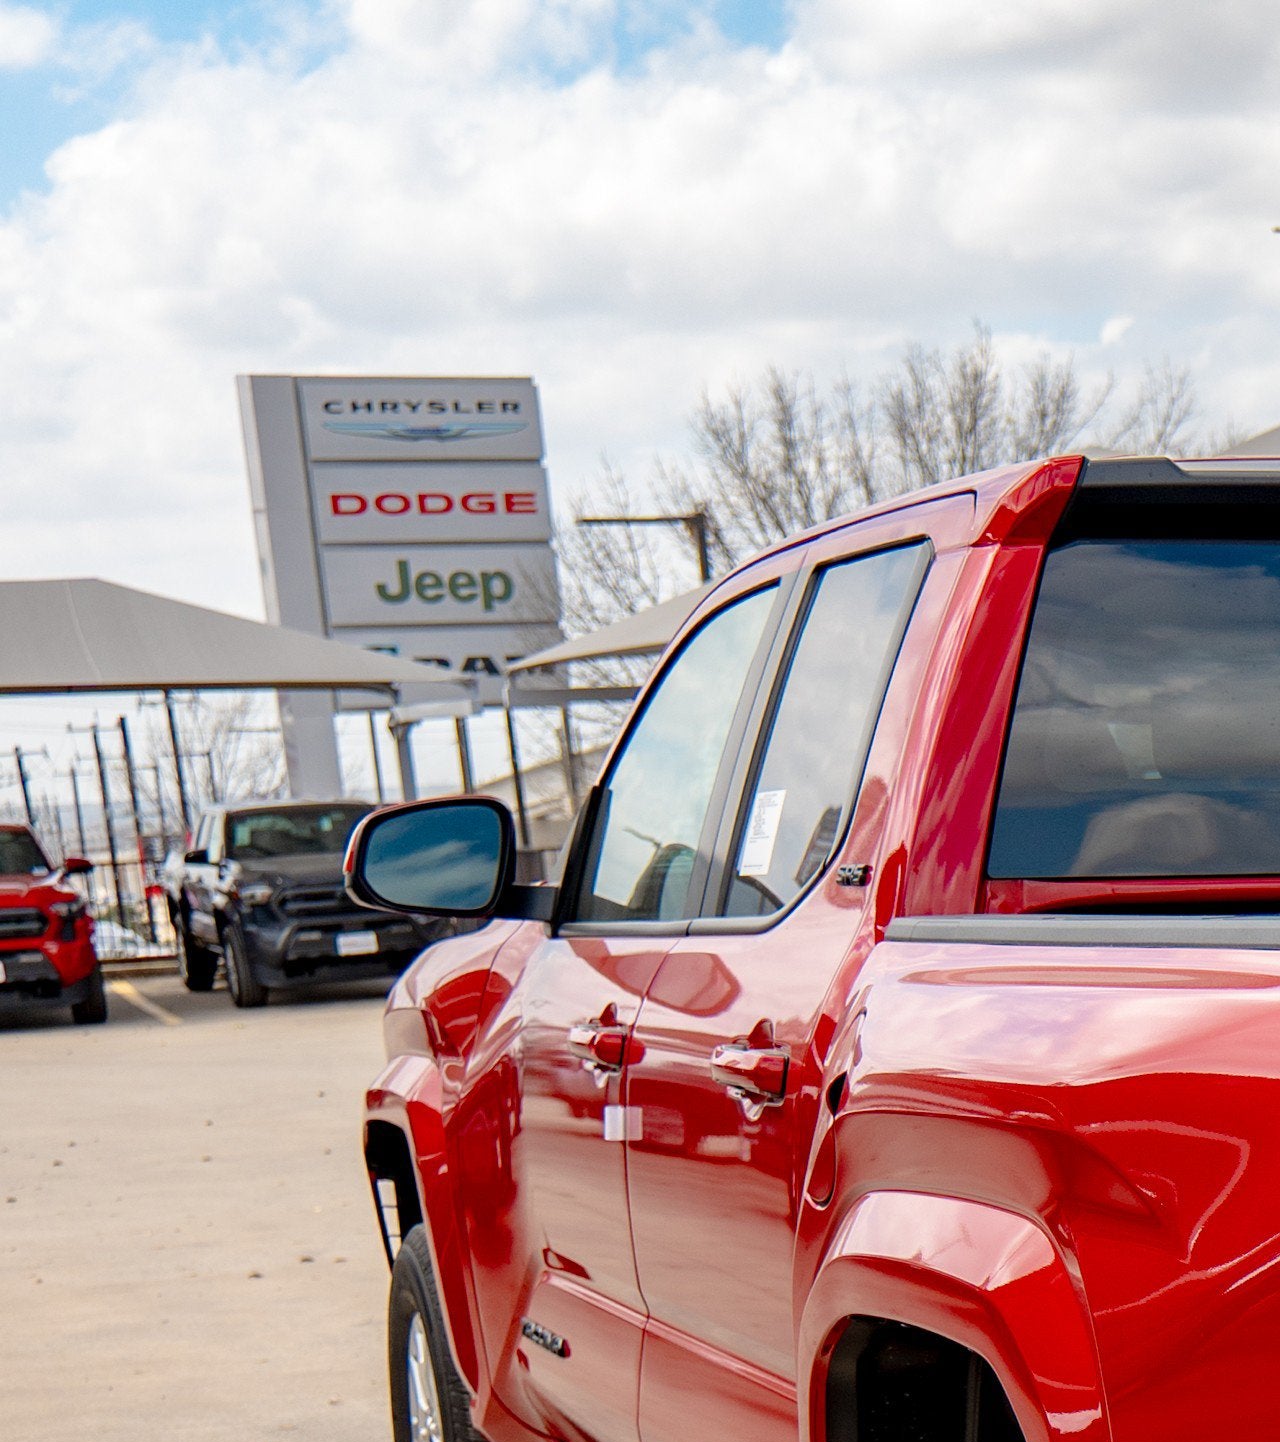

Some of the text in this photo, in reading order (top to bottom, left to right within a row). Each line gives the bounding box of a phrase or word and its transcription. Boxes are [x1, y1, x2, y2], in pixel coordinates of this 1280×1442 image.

[322, 400, 521, 415] CHRYSLER
[330, 492, 538, 516] DODGE
[376, 559, 515, 612] Jeep
